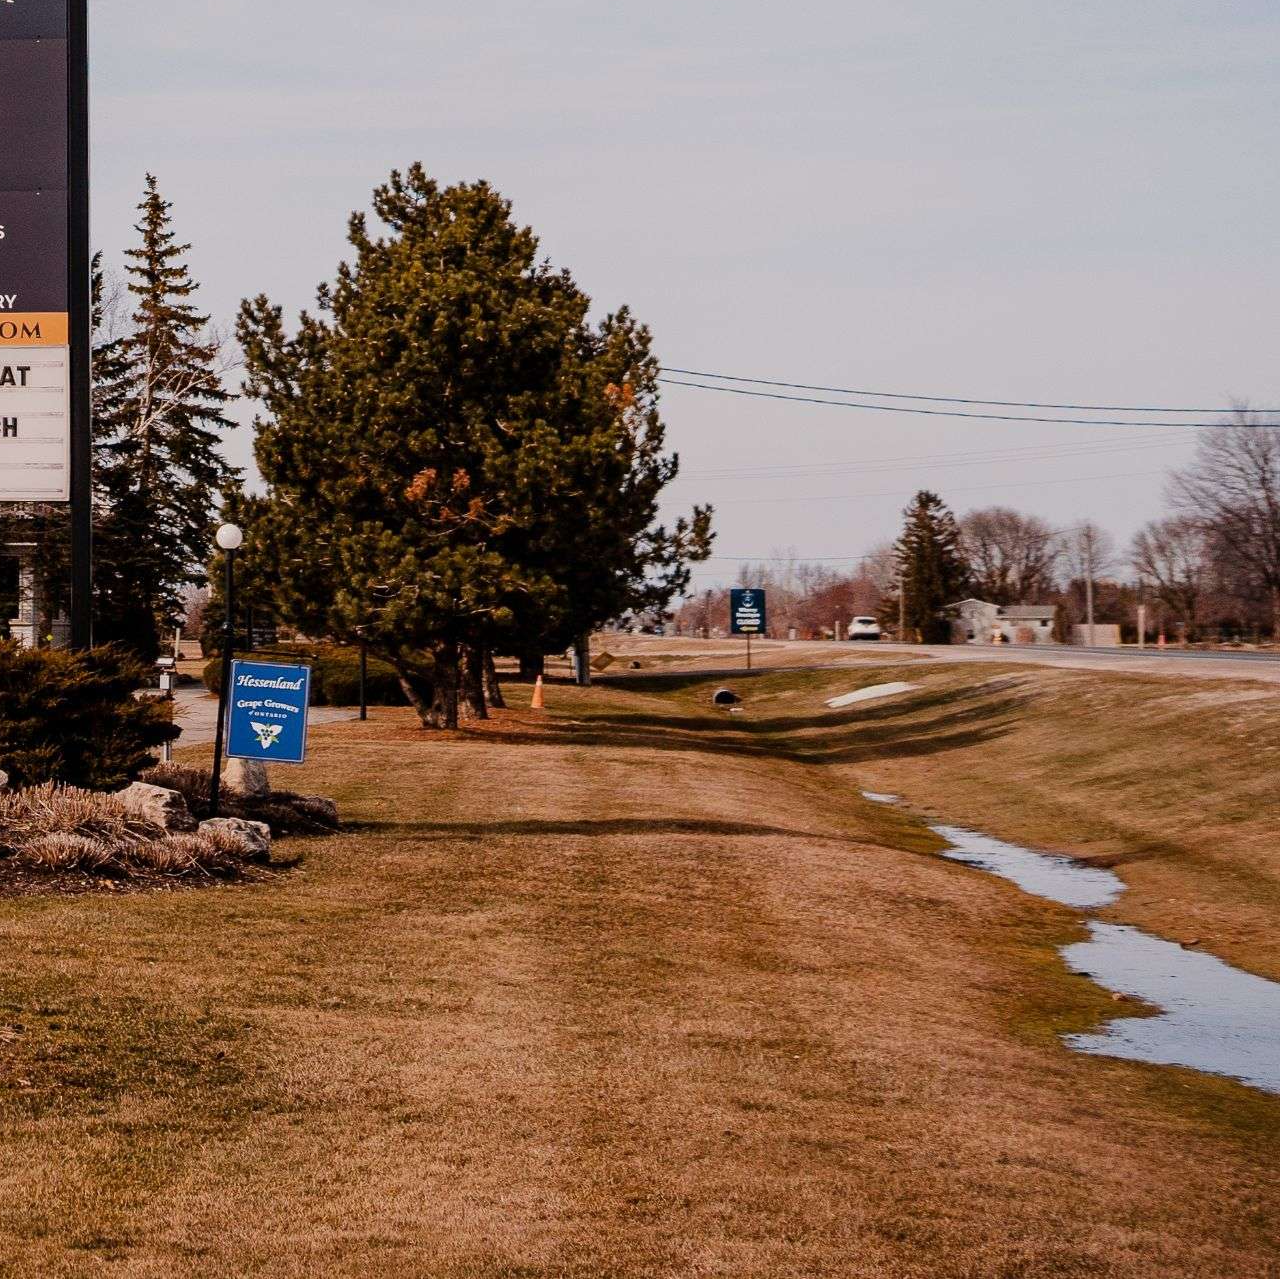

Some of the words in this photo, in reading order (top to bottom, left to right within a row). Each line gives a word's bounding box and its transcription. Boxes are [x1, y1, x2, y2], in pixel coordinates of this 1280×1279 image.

[236, 675, 304, 690] Hessenland
[237, 699, 263, 709] Grape
[264, 699, 300, 713] Growers
